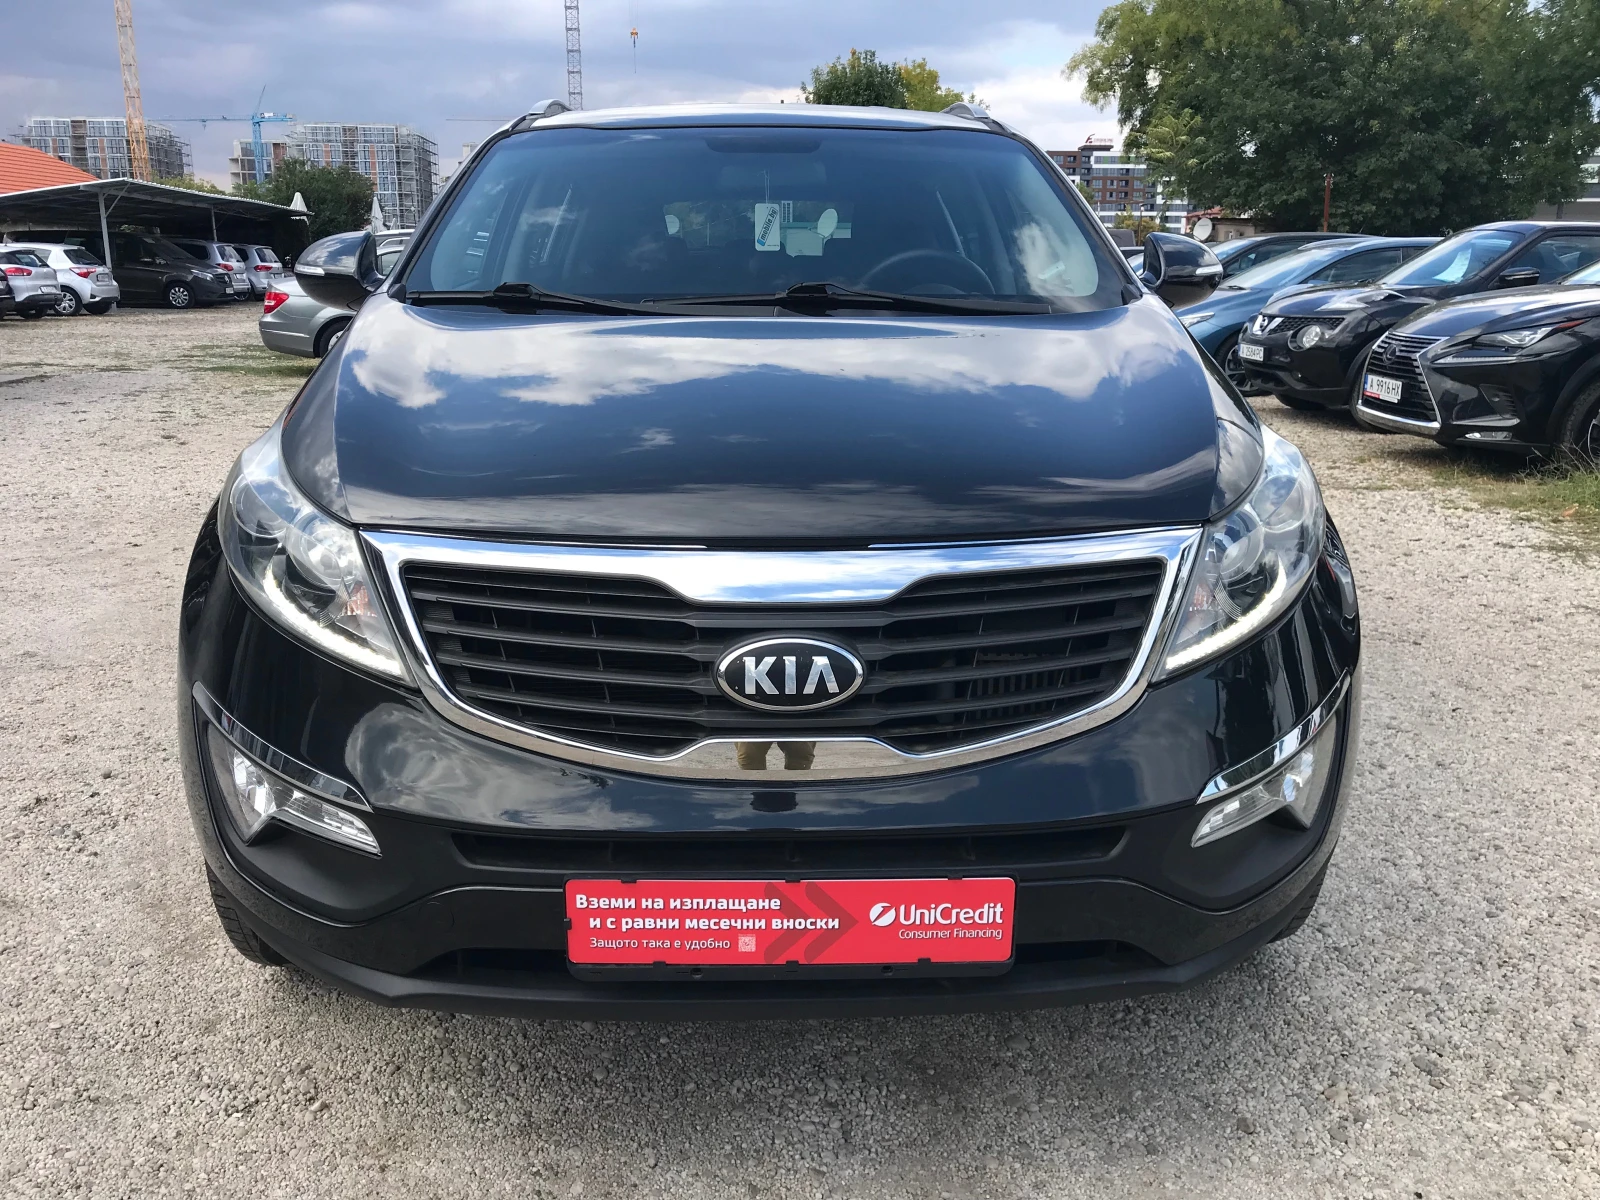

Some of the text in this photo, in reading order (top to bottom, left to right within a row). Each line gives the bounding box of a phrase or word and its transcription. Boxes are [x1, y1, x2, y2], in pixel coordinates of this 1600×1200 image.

[743, 656, 839, 695] KIA
[575, 894, 781, 912] Вземи на изплащане
[899, 902, 1004, 925] UniCredit
[589, 917, 840, 932] и с равни месечни вноски
[898, 927, 1003, 940] Consumer Financing
[589, 937, 731, 951] Защото така е удобно
